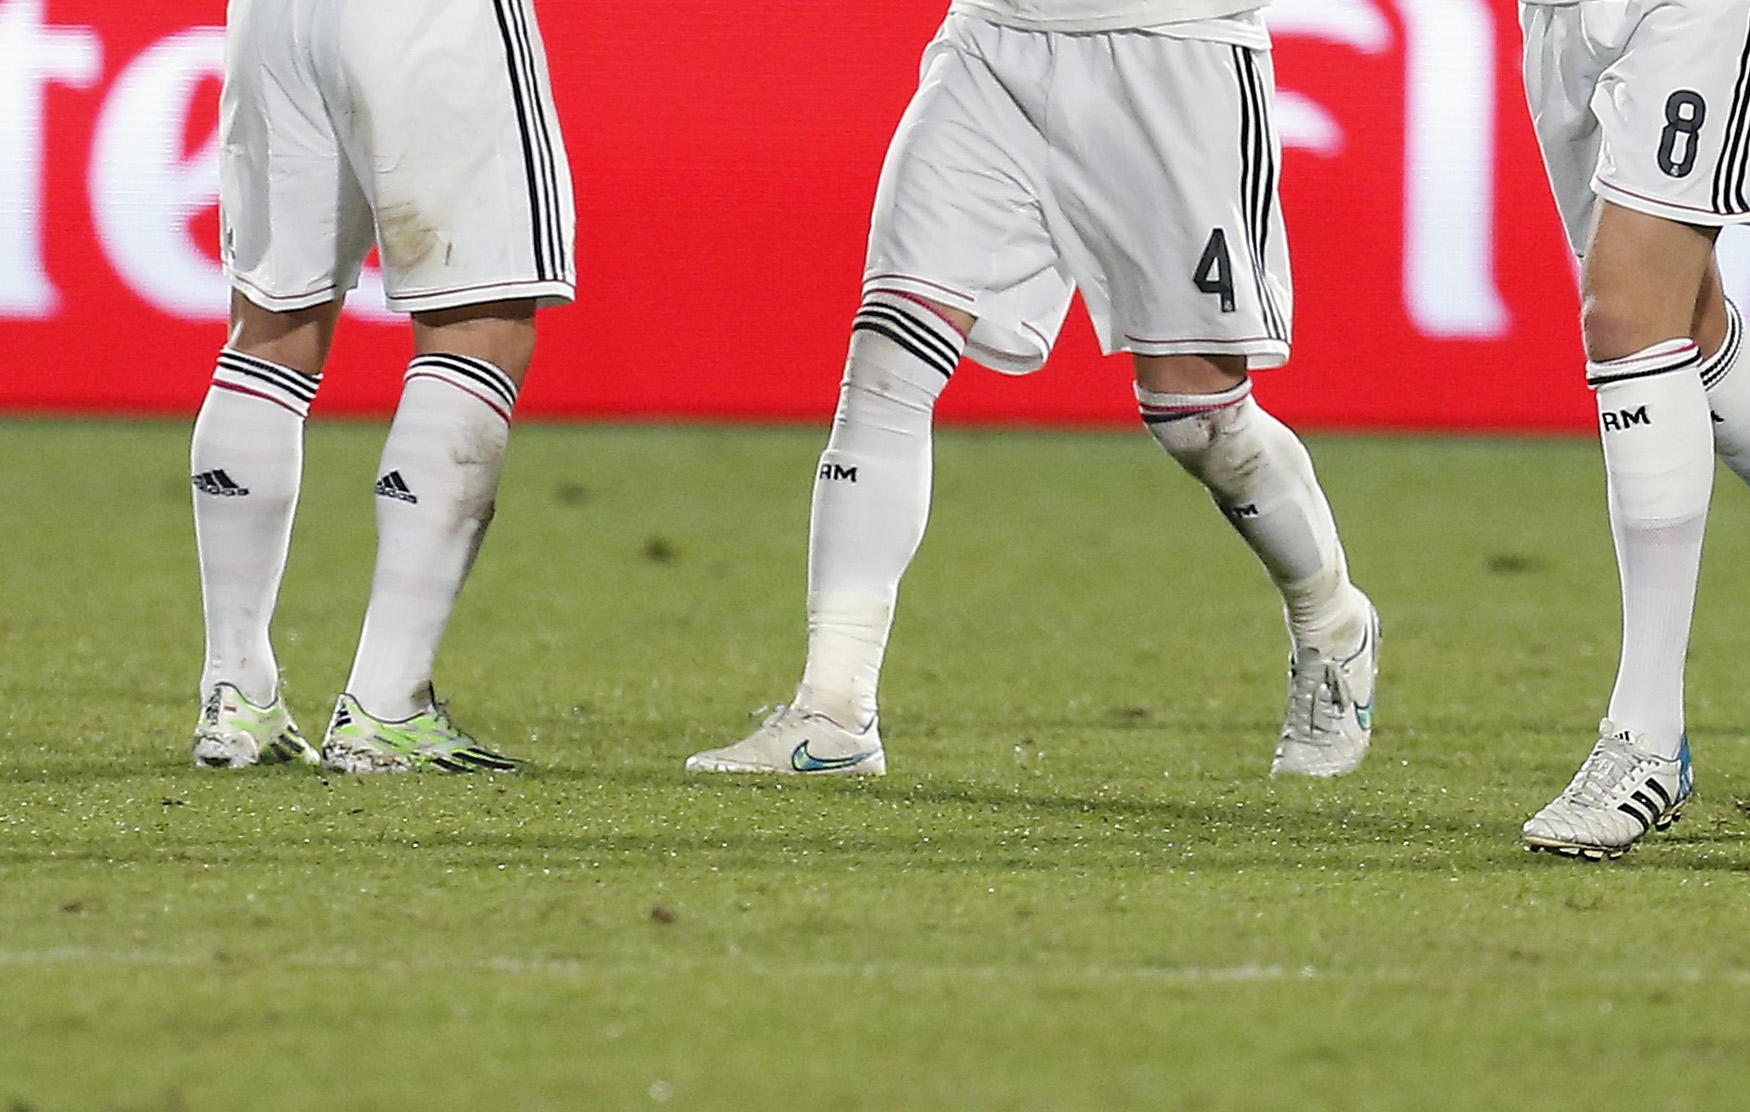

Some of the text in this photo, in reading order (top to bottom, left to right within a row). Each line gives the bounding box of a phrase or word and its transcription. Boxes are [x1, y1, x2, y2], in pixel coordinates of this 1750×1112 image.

[1657, 89, 1706, 178] 8
[1193, 228, 1236, 312] 4
[1602, 406, 1651, 432] RM
[820, 464, 857, 483] RM
